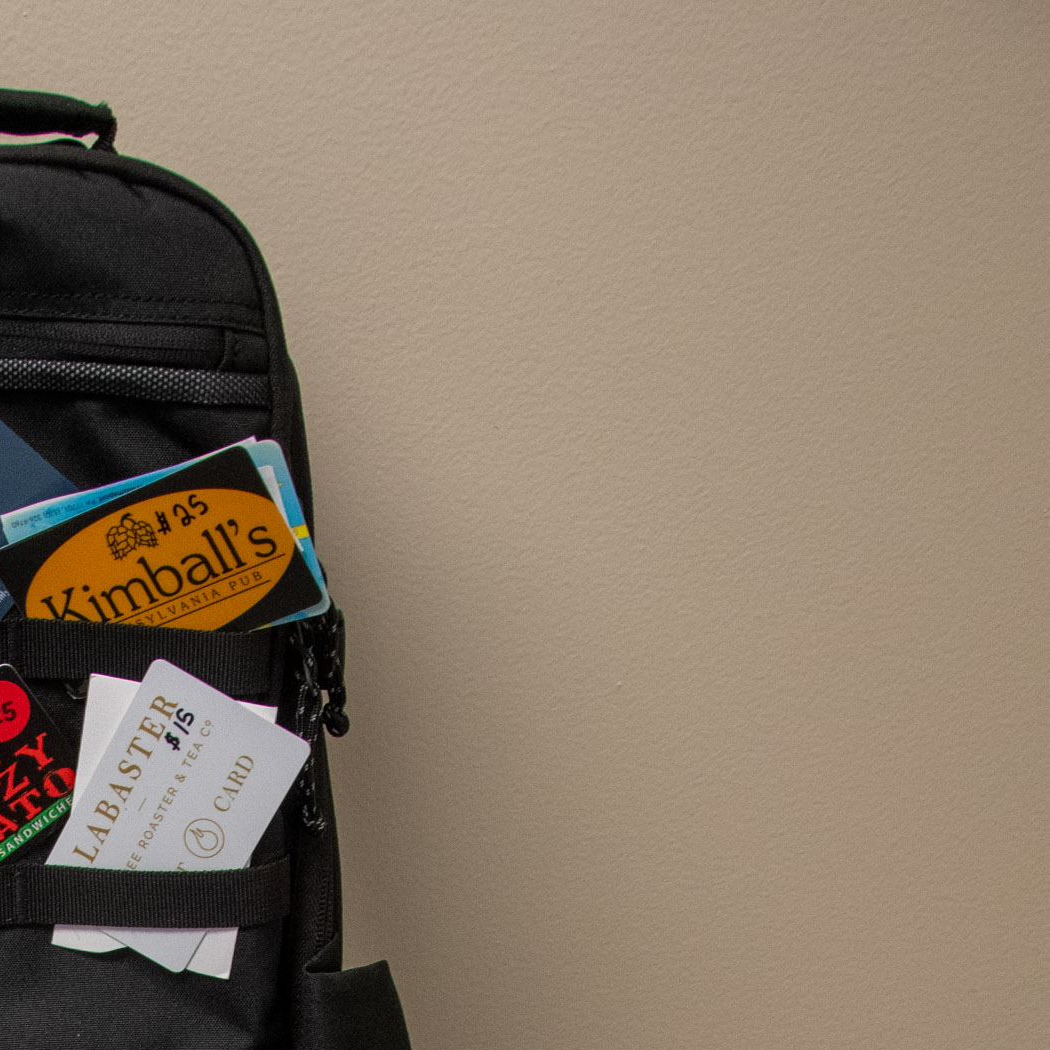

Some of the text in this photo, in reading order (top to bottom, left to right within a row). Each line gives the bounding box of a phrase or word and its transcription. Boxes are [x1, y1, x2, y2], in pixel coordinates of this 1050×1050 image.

[155, 494, 209, 535] $25
[41, 519, 276, 622] Kimball's
[135, 571, 263, 627] SYLVANIA PUB
[165, 708, 194, 751] $15
[73, 696, 178, 864] LABASTER
[138, 787, 178, 848] ROASTER
[175, 774, 186, 782] &
[182, 742, 203, 768] TEA
[213, 755, 254, 813] CARD
